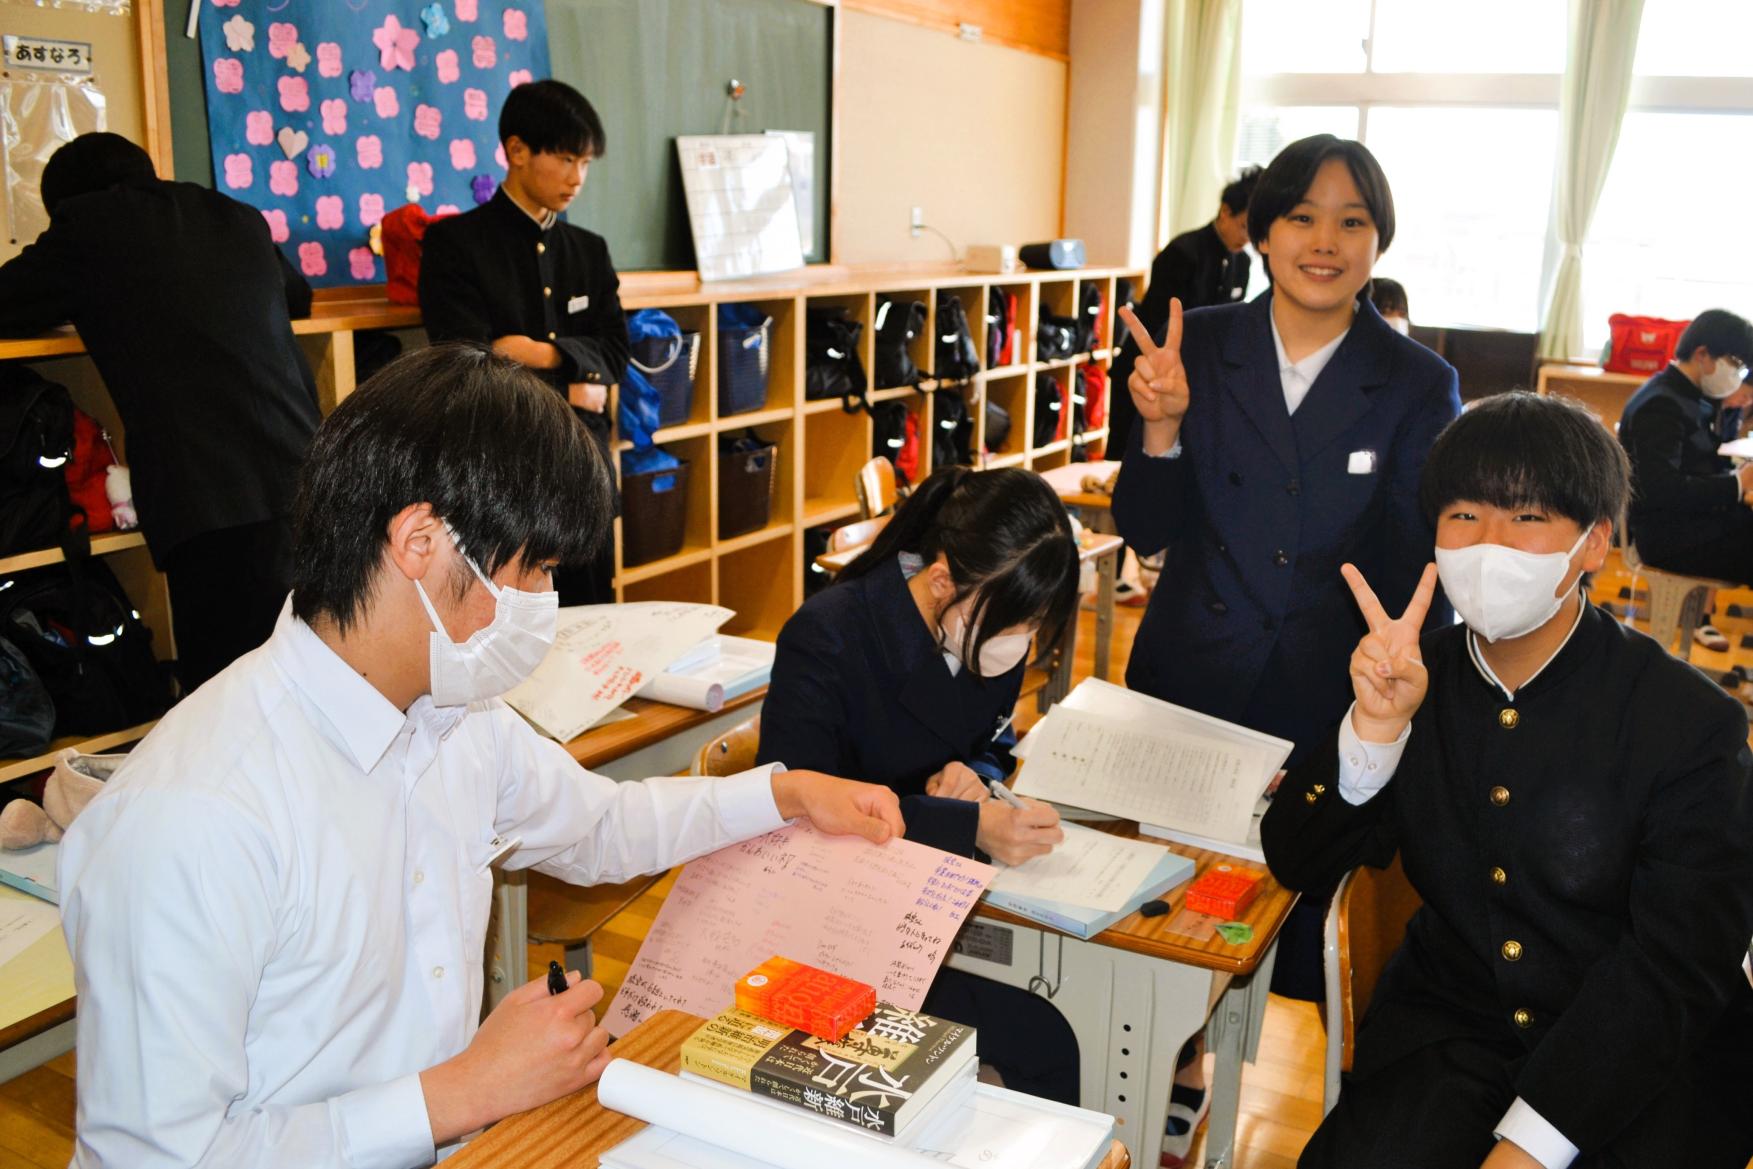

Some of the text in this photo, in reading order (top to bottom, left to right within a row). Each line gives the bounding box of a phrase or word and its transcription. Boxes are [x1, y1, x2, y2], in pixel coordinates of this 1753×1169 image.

[16, 44, 81, 66] あすなろ
[812, 1047, 912, 1109] 水戸
[803, 1086, 885, 1130] 水戸維新
